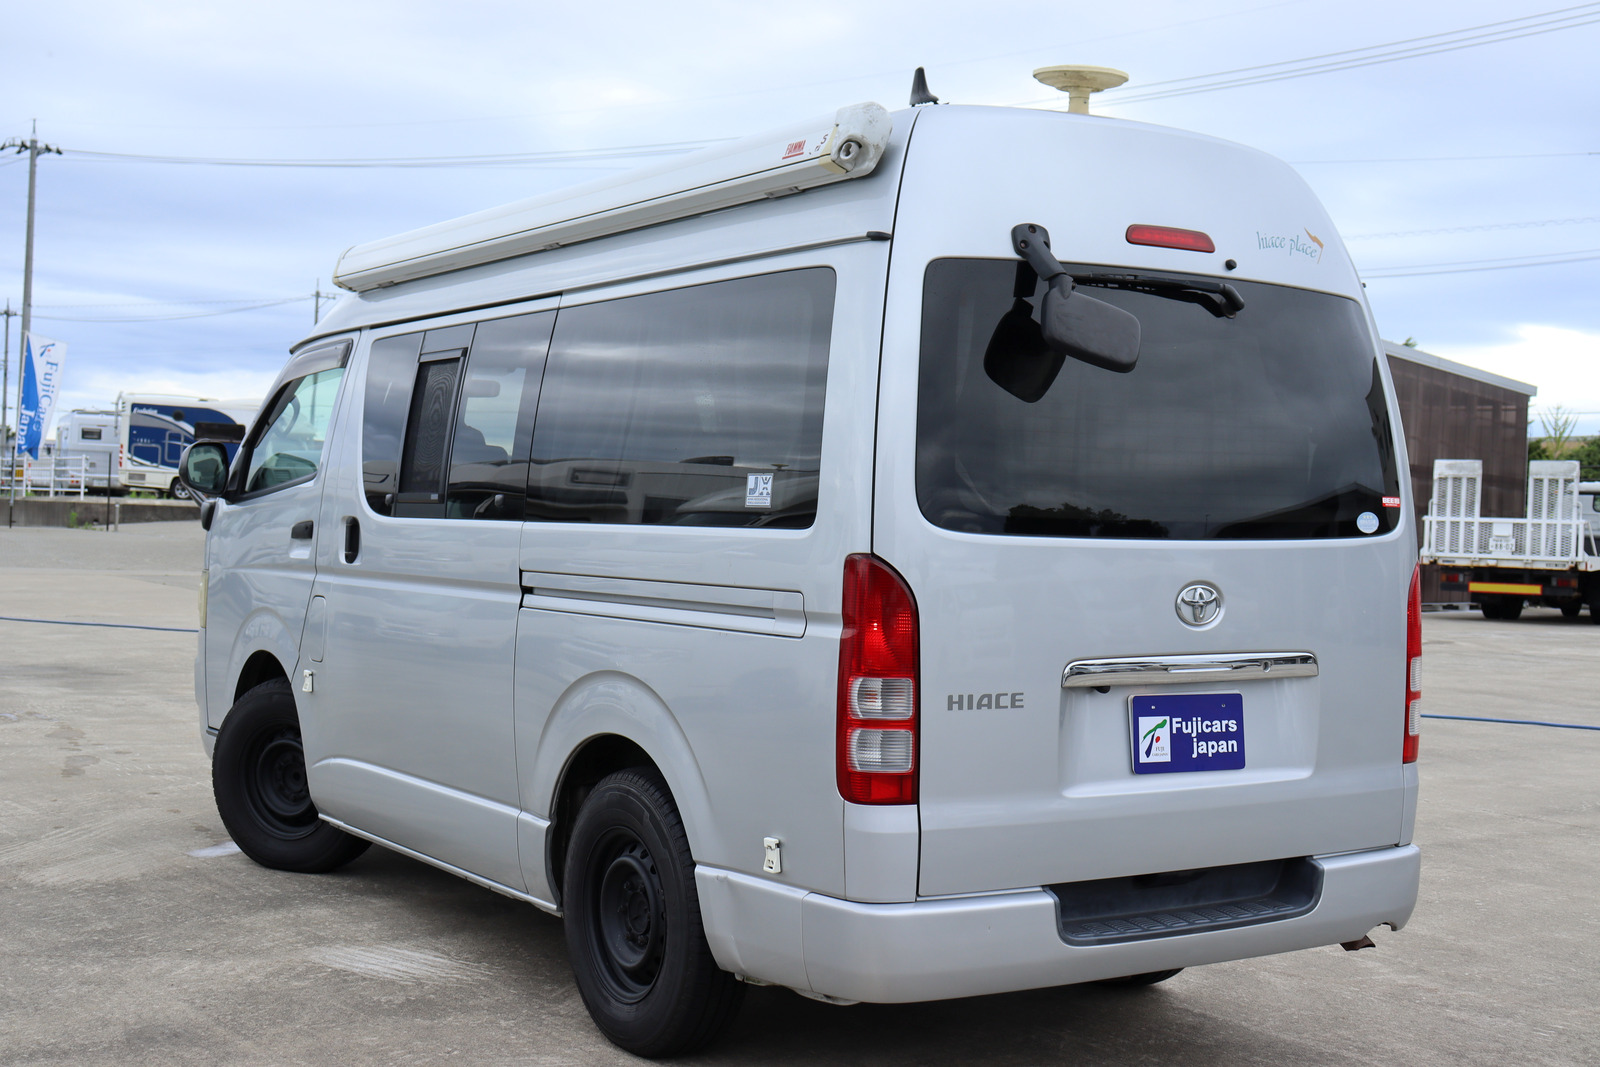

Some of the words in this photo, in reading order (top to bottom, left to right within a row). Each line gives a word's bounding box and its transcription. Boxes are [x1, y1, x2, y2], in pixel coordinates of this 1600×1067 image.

[784, 139, 807, 156] FIAMMA
[1256, 231, 1286, 250] hiace
[1289, 234, 1318, 258] place
[17, 404, 36, 451] Japa
[947, 692, 1025, 711] HIACE
[1171, 717, 1238, 738] Fujicars
[1191, 738, 1238, 758] japan
